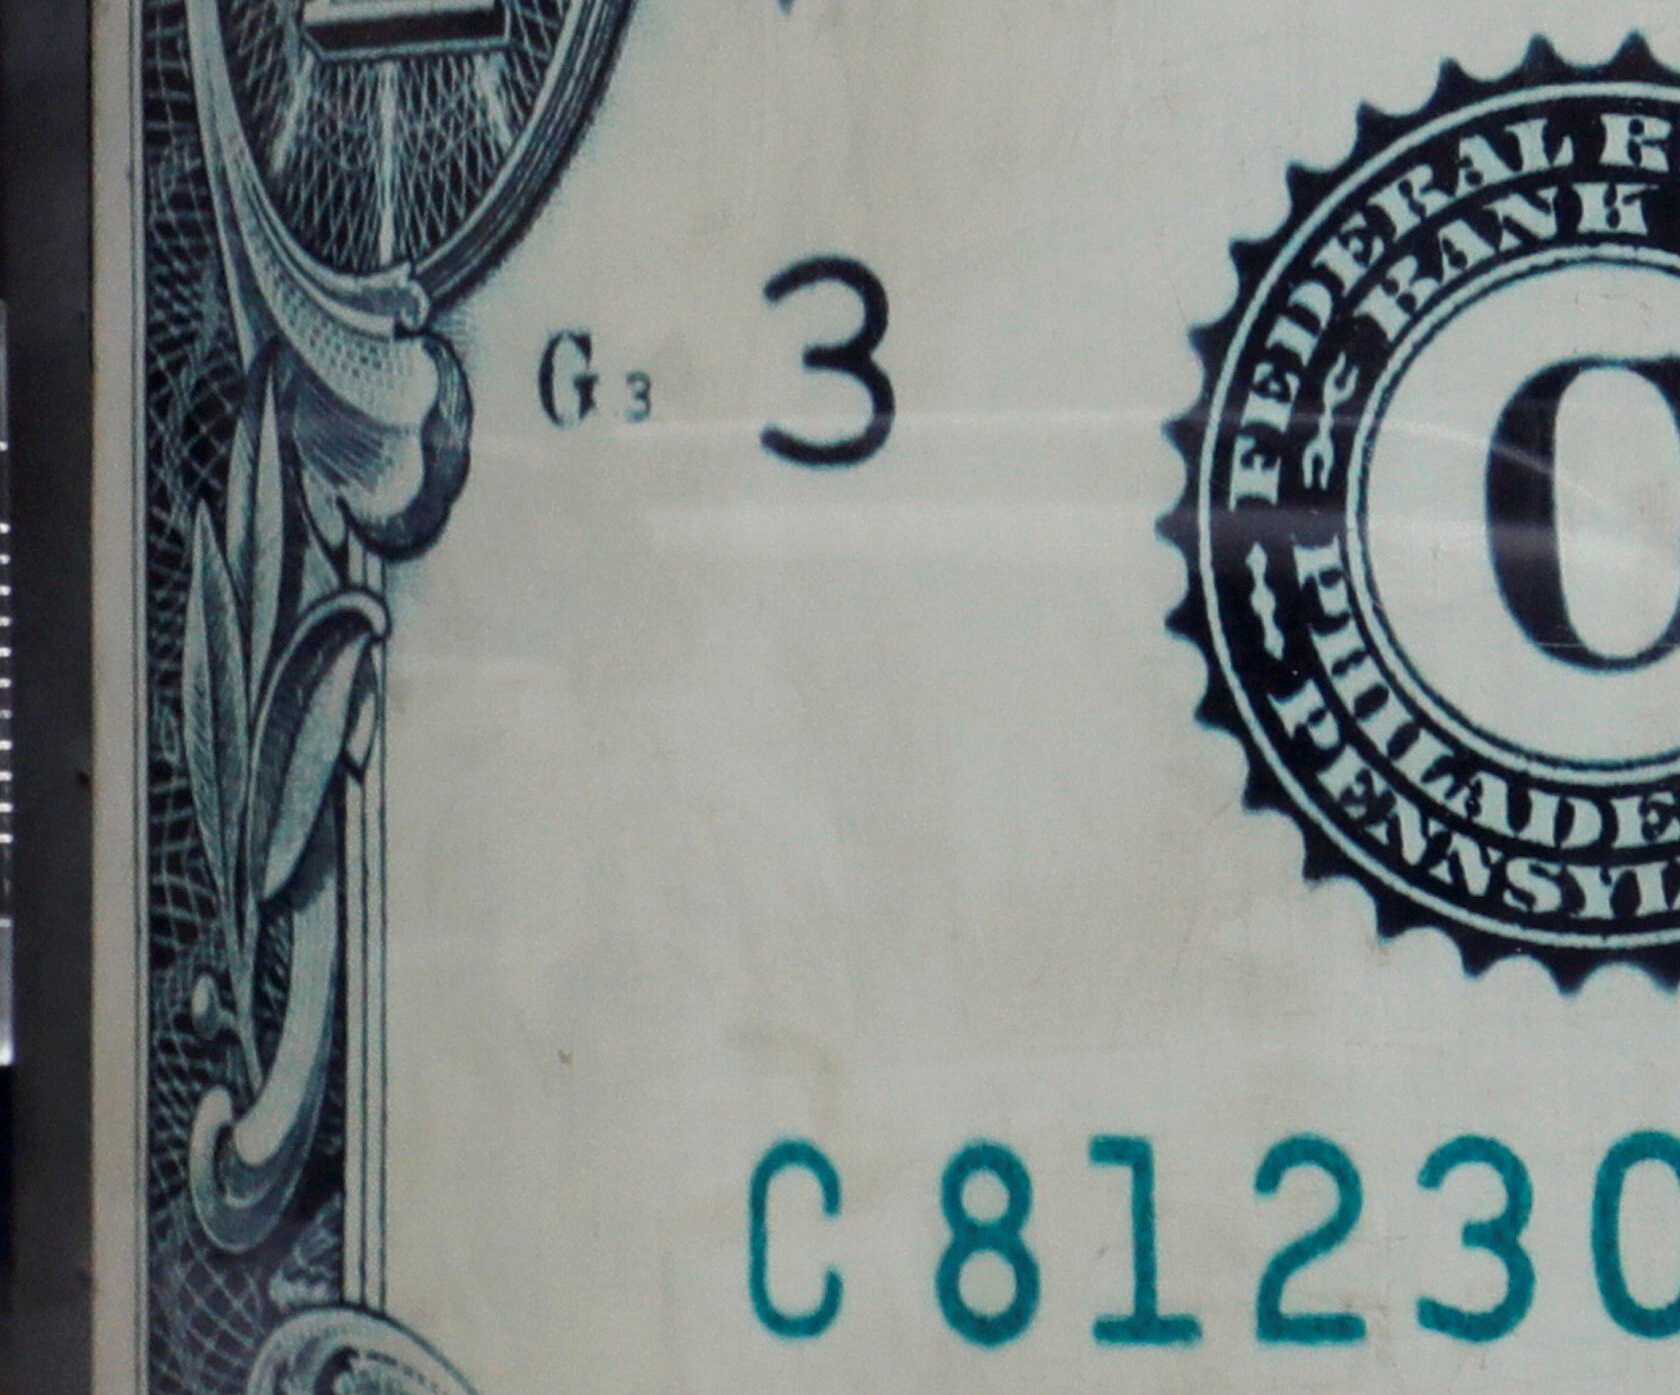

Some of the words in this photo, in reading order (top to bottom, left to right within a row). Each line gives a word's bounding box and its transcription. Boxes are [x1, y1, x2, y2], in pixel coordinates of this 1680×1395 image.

[759, 253, 896, 471] 3
[1228, 115, 1574, 509] FEDERAL
[1356, 180, 1668, 350] BANK
